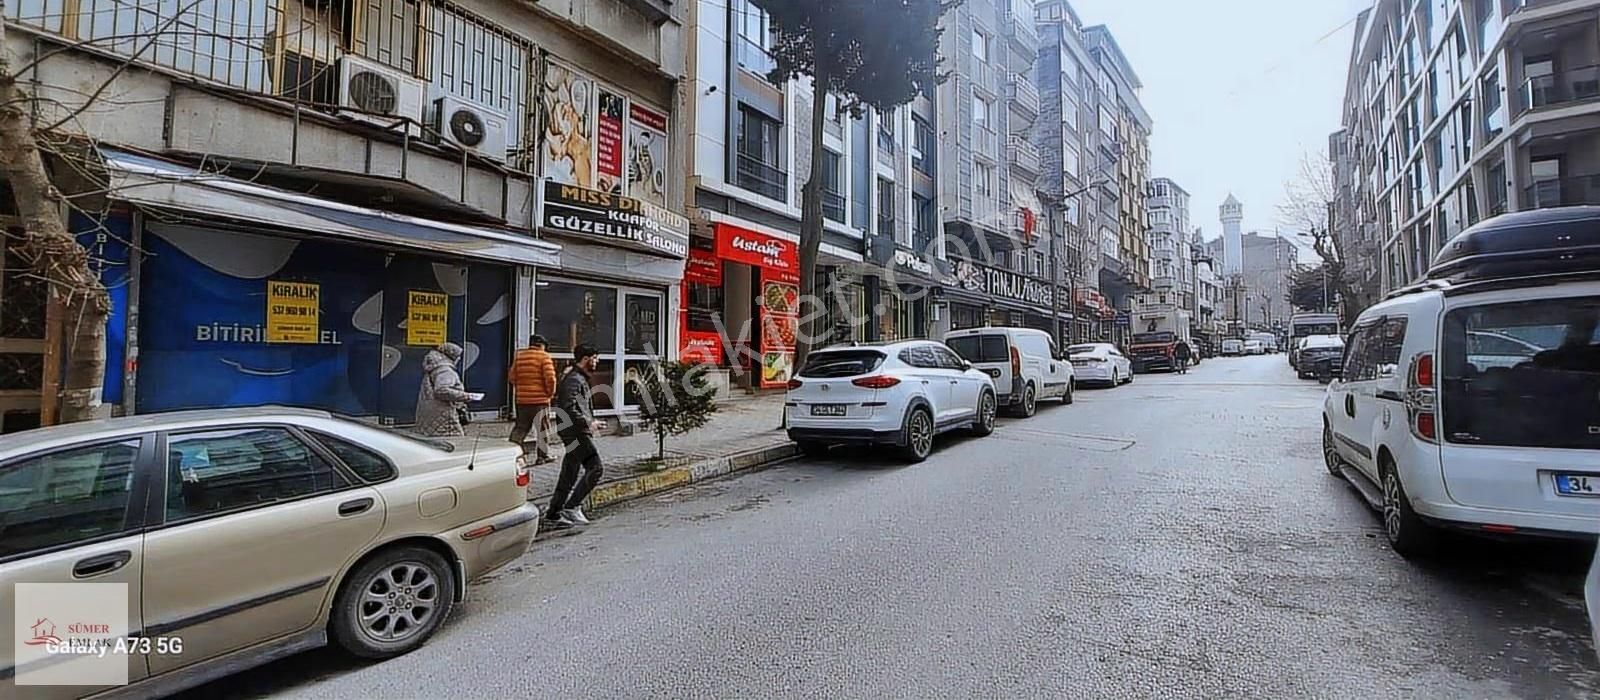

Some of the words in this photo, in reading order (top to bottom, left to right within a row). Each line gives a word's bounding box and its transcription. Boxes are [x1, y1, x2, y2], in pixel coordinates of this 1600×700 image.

[561, 185, 611, 207] MISS
[550, 215, 644, 241] GÜZELLİK
[646, 232, 687, 256] SALONU
[984, 267, 1021, 299] TANJU
[1569, 477, 1593, 492] 34
